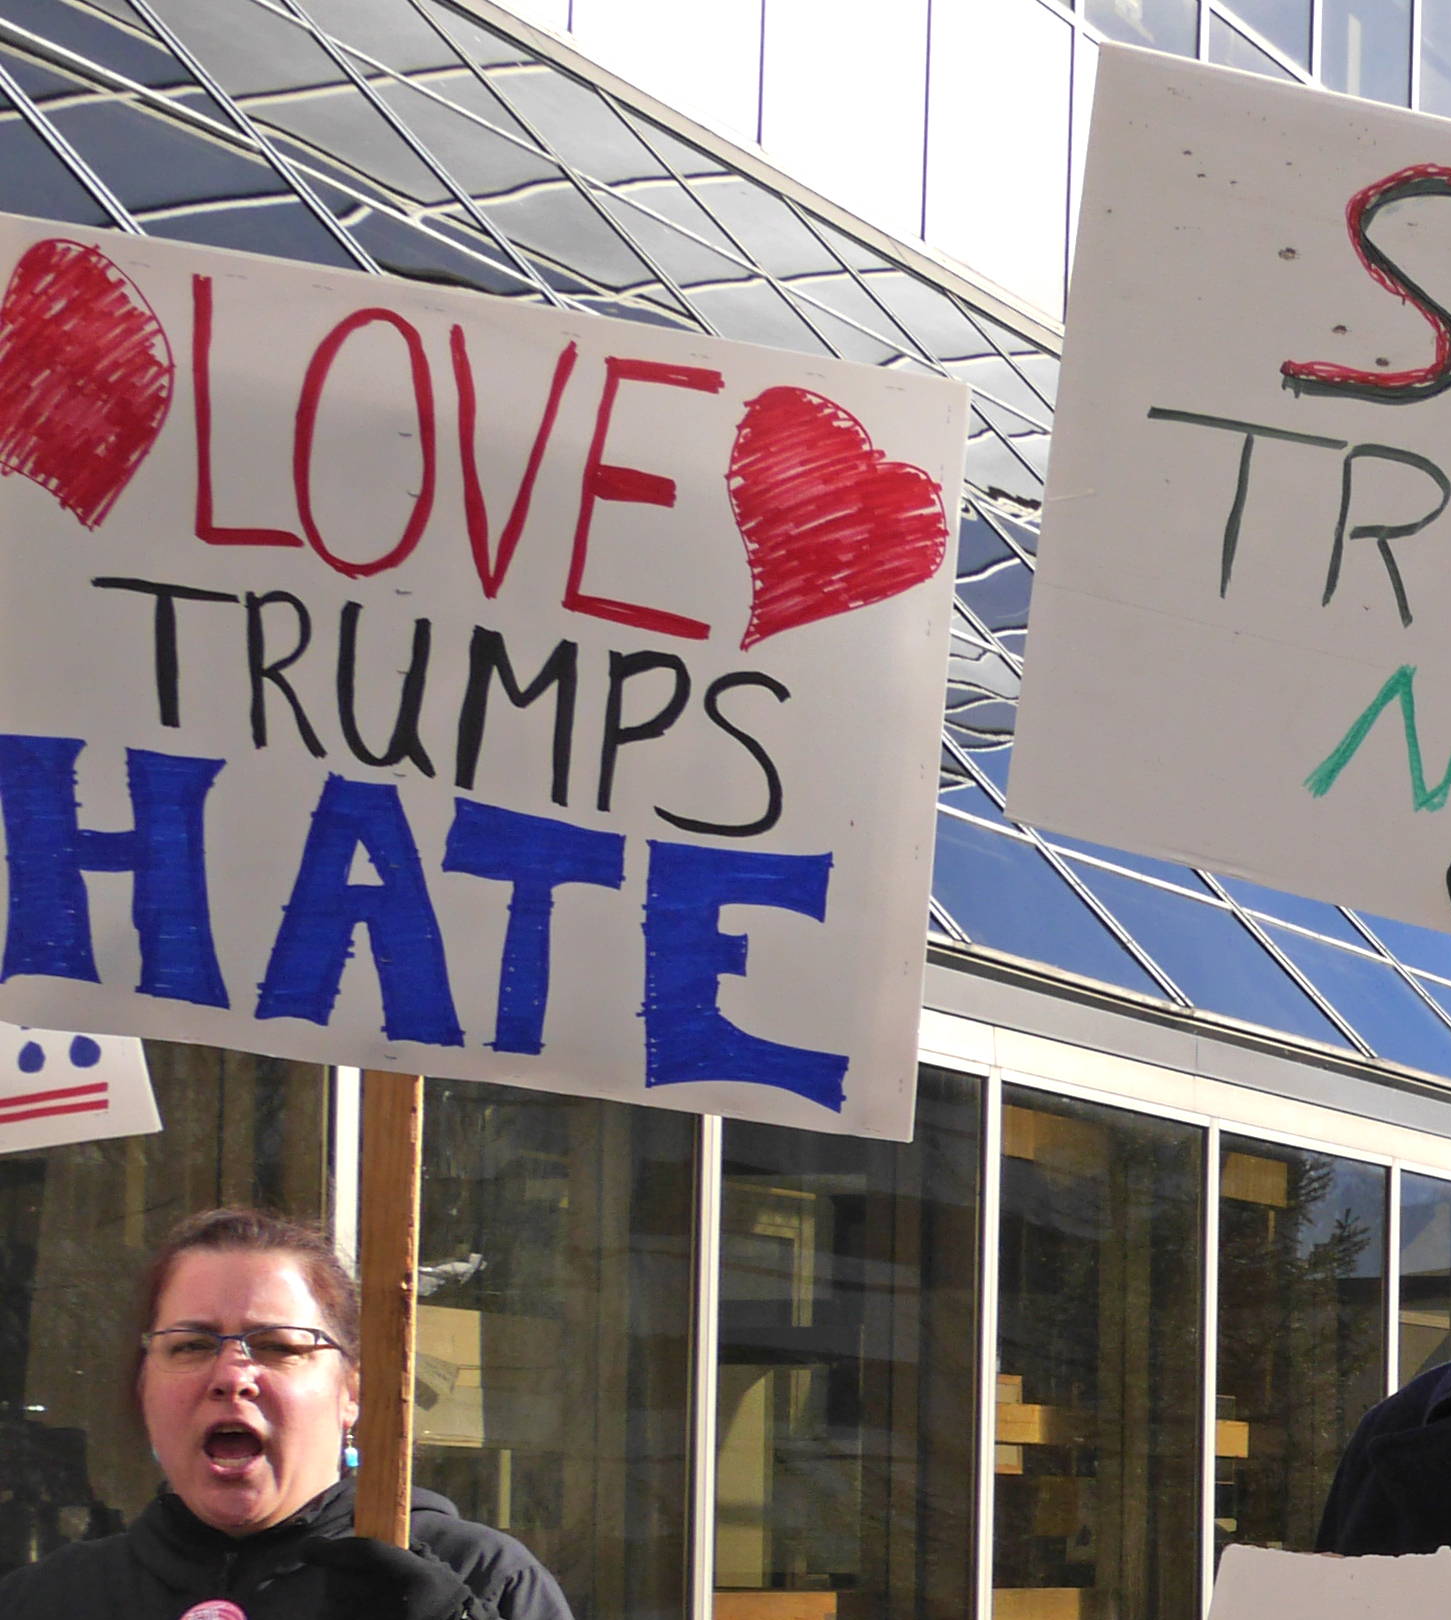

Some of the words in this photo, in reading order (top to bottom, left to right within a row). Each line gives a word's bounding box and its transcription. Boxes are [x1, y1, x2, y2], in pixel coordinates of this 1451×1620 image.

[193, 274, 725, 640] LOVE
[91, 577, 791, 836] TRUMPS
[0, 735, 848, 1112] HATE
